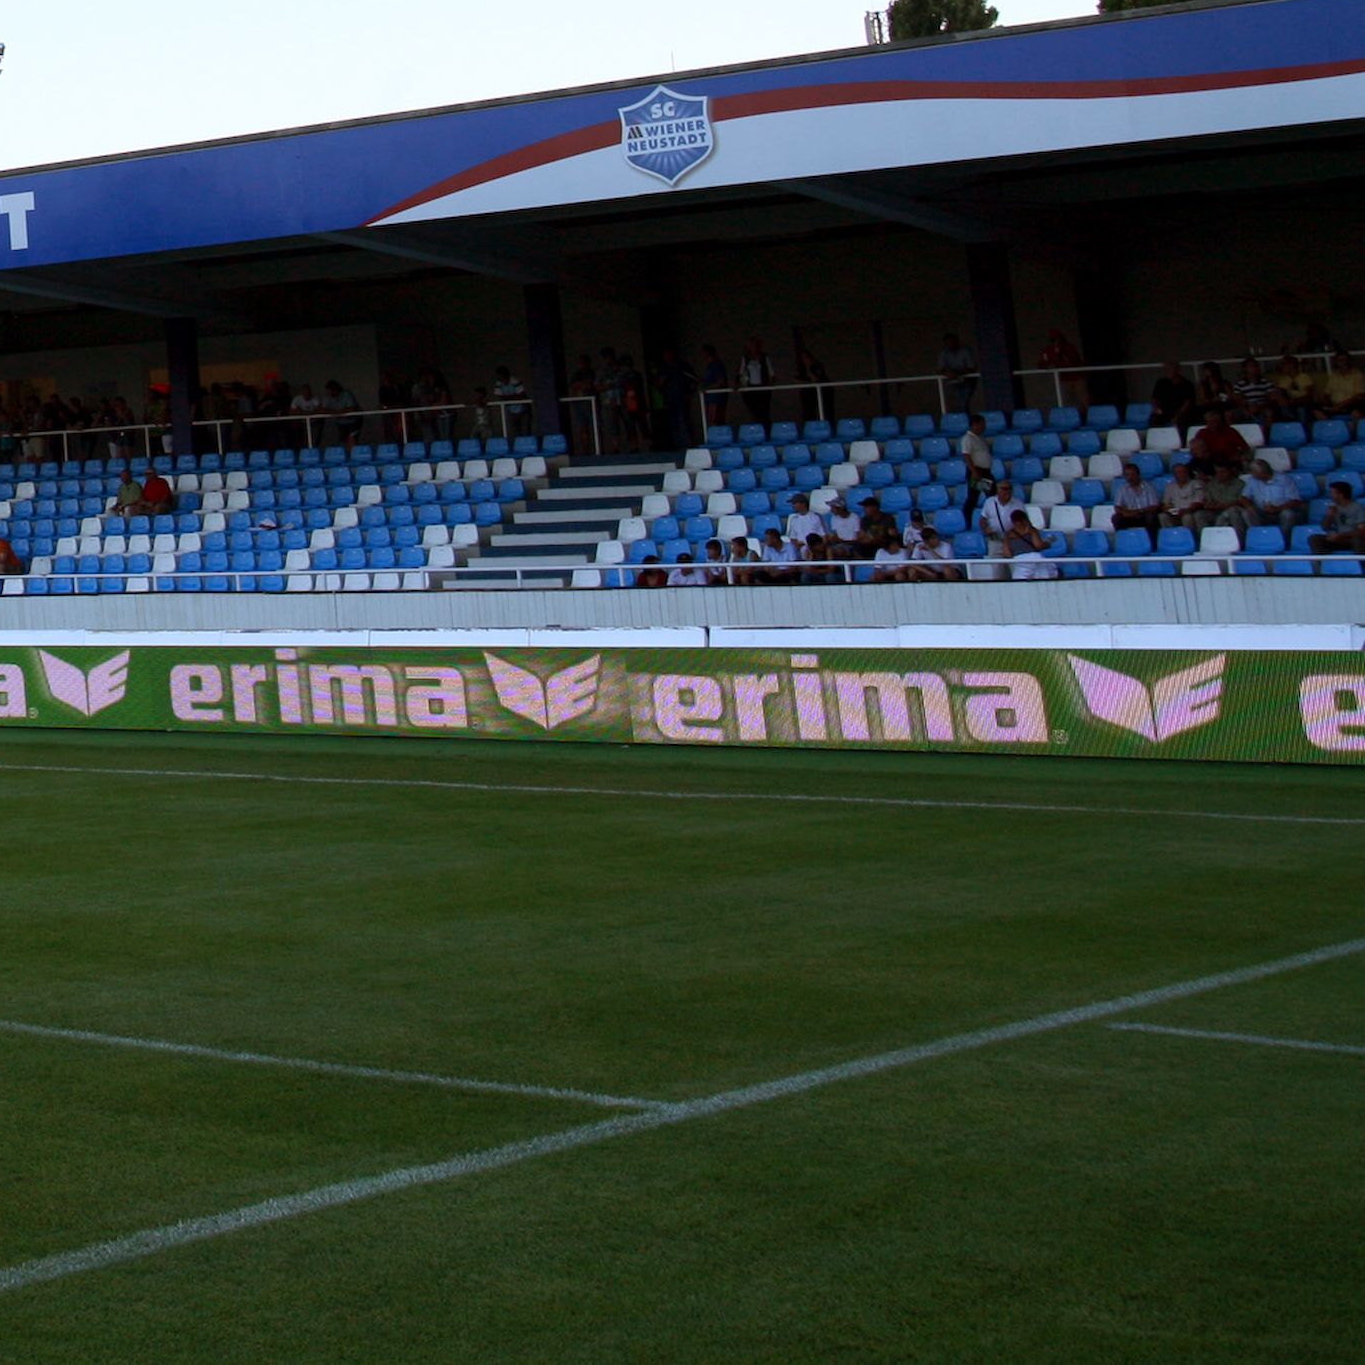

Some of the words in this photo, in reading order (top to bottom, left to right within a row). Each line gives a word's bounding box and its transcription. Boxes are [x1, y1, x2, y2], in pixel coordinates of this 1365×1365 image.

[650, 101, 675, 118] SC
[645, 120, 705, 137] WIENER
[627, 132, 706, 153] NEUSTADT
[170, 649, 468, 728] erima
[652, 653, 1048, 744] erima
